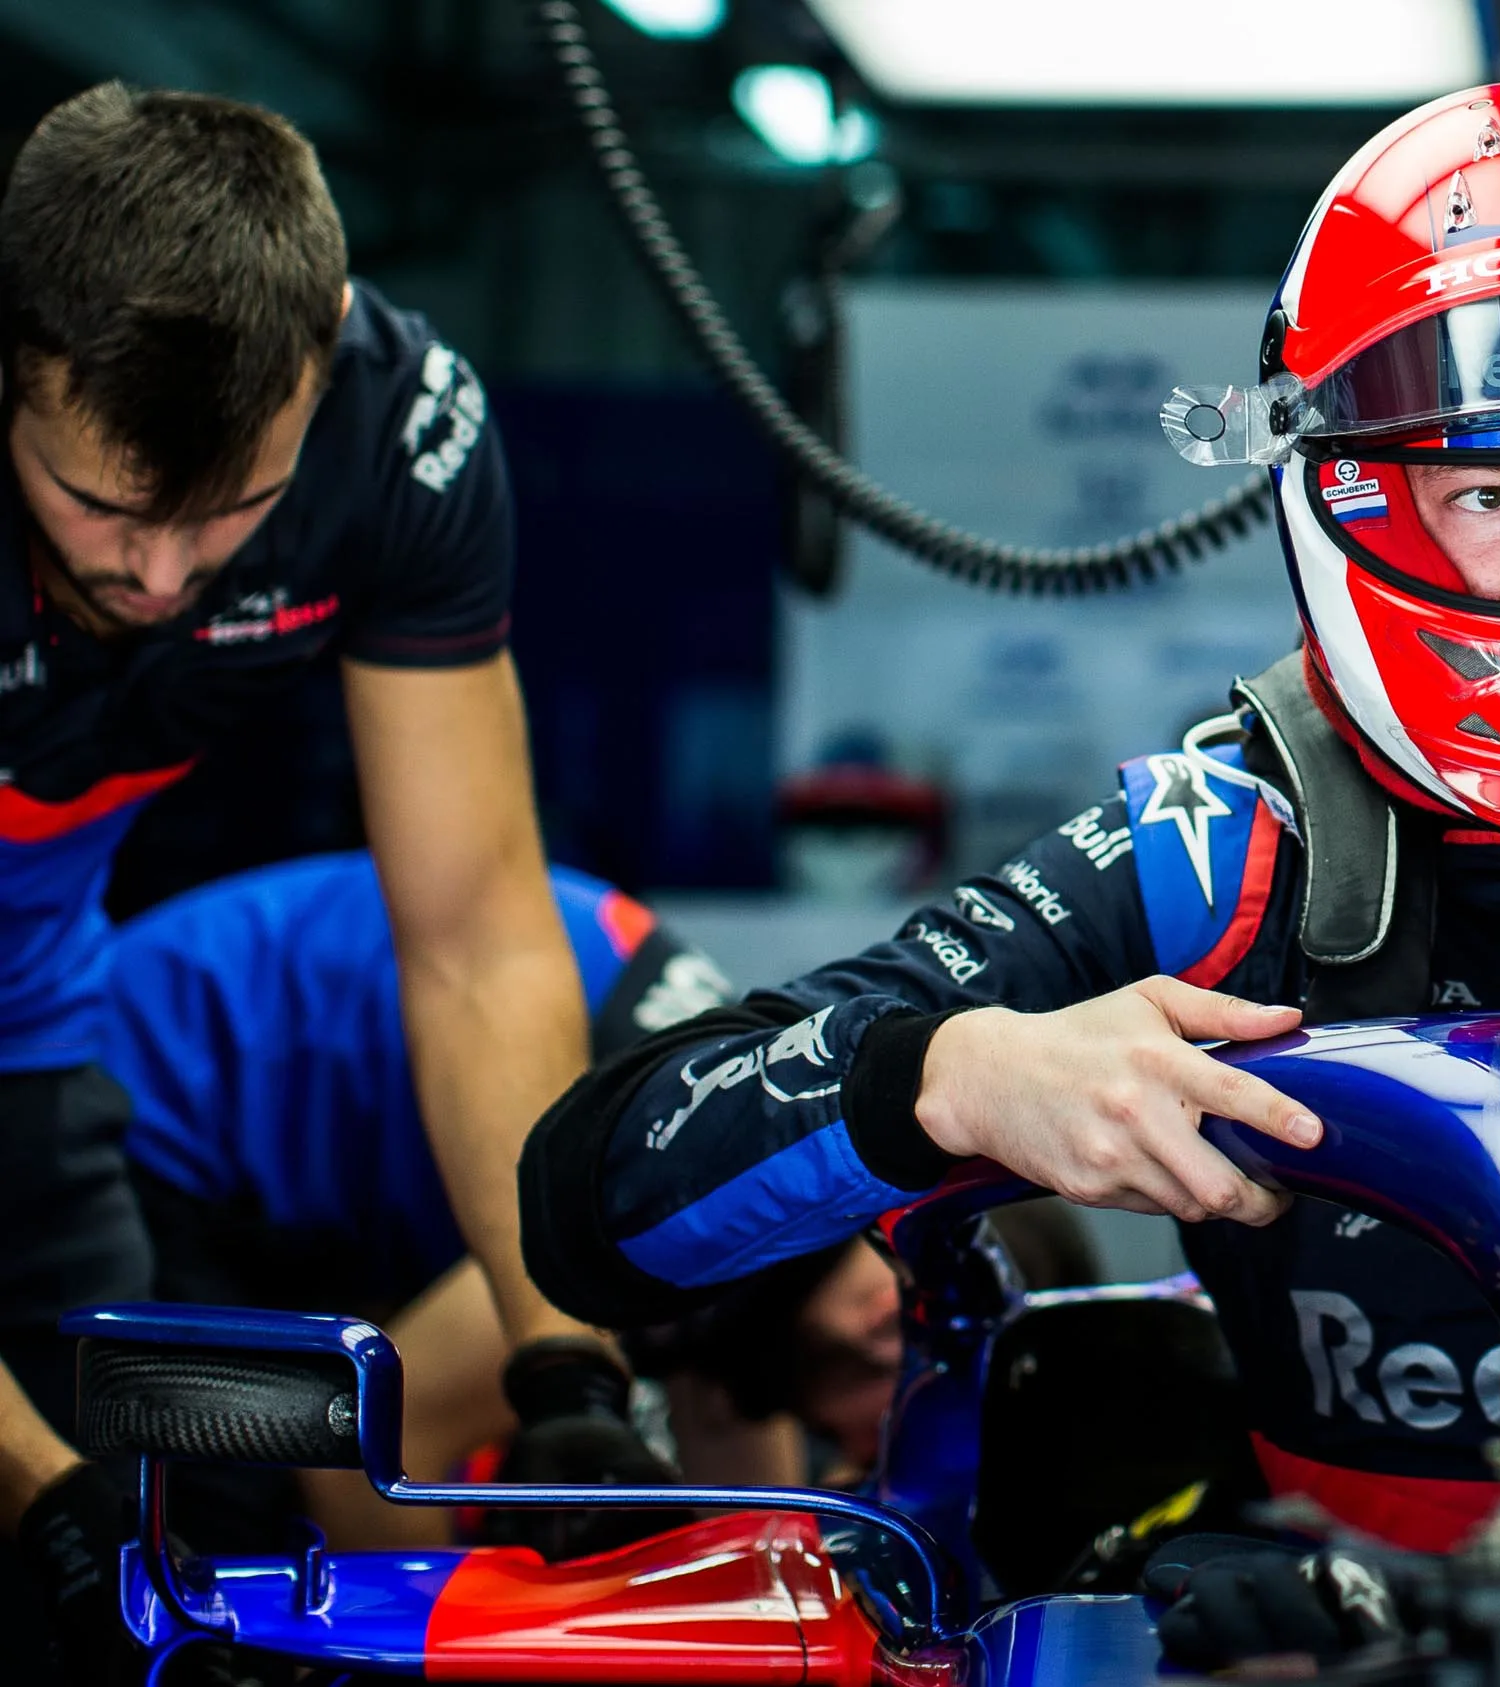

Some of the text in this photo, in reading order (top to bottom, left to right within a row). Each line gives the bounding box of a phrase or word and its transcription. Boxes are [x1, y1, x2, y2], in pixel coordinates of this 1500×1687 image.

[411, 406, 479, 494] Red
[1326, 482, 1377, 498] SCHUBERTH
[1057, 805, 1134, 871] Bull
